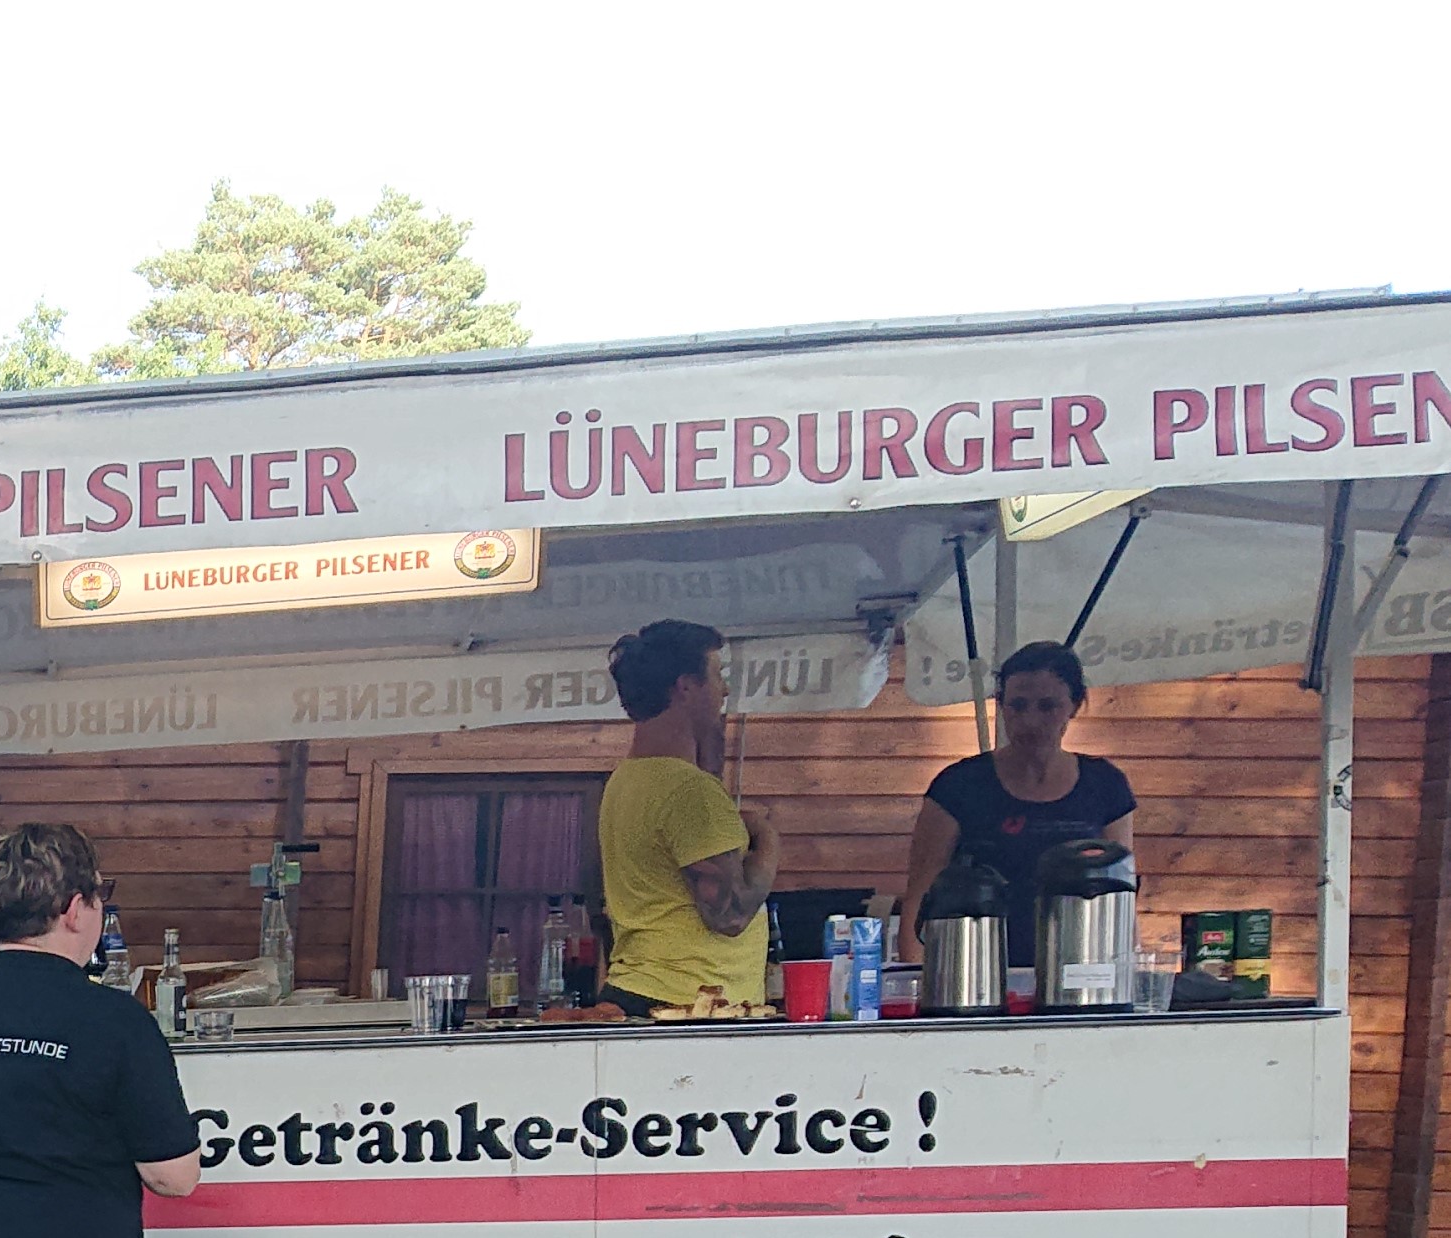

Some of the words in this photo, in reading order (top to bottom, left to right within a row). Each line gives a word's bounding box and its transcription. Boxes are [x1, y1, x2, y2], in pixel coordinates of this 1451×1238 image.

[504, 393, 1109, 503] LÜNEBURGER
[144, 560, 299, 592] LÜNEBURGER
[315, 549, 430, 578] PILSENER
[192, 1093, 892, 1169] Getränke-Service
